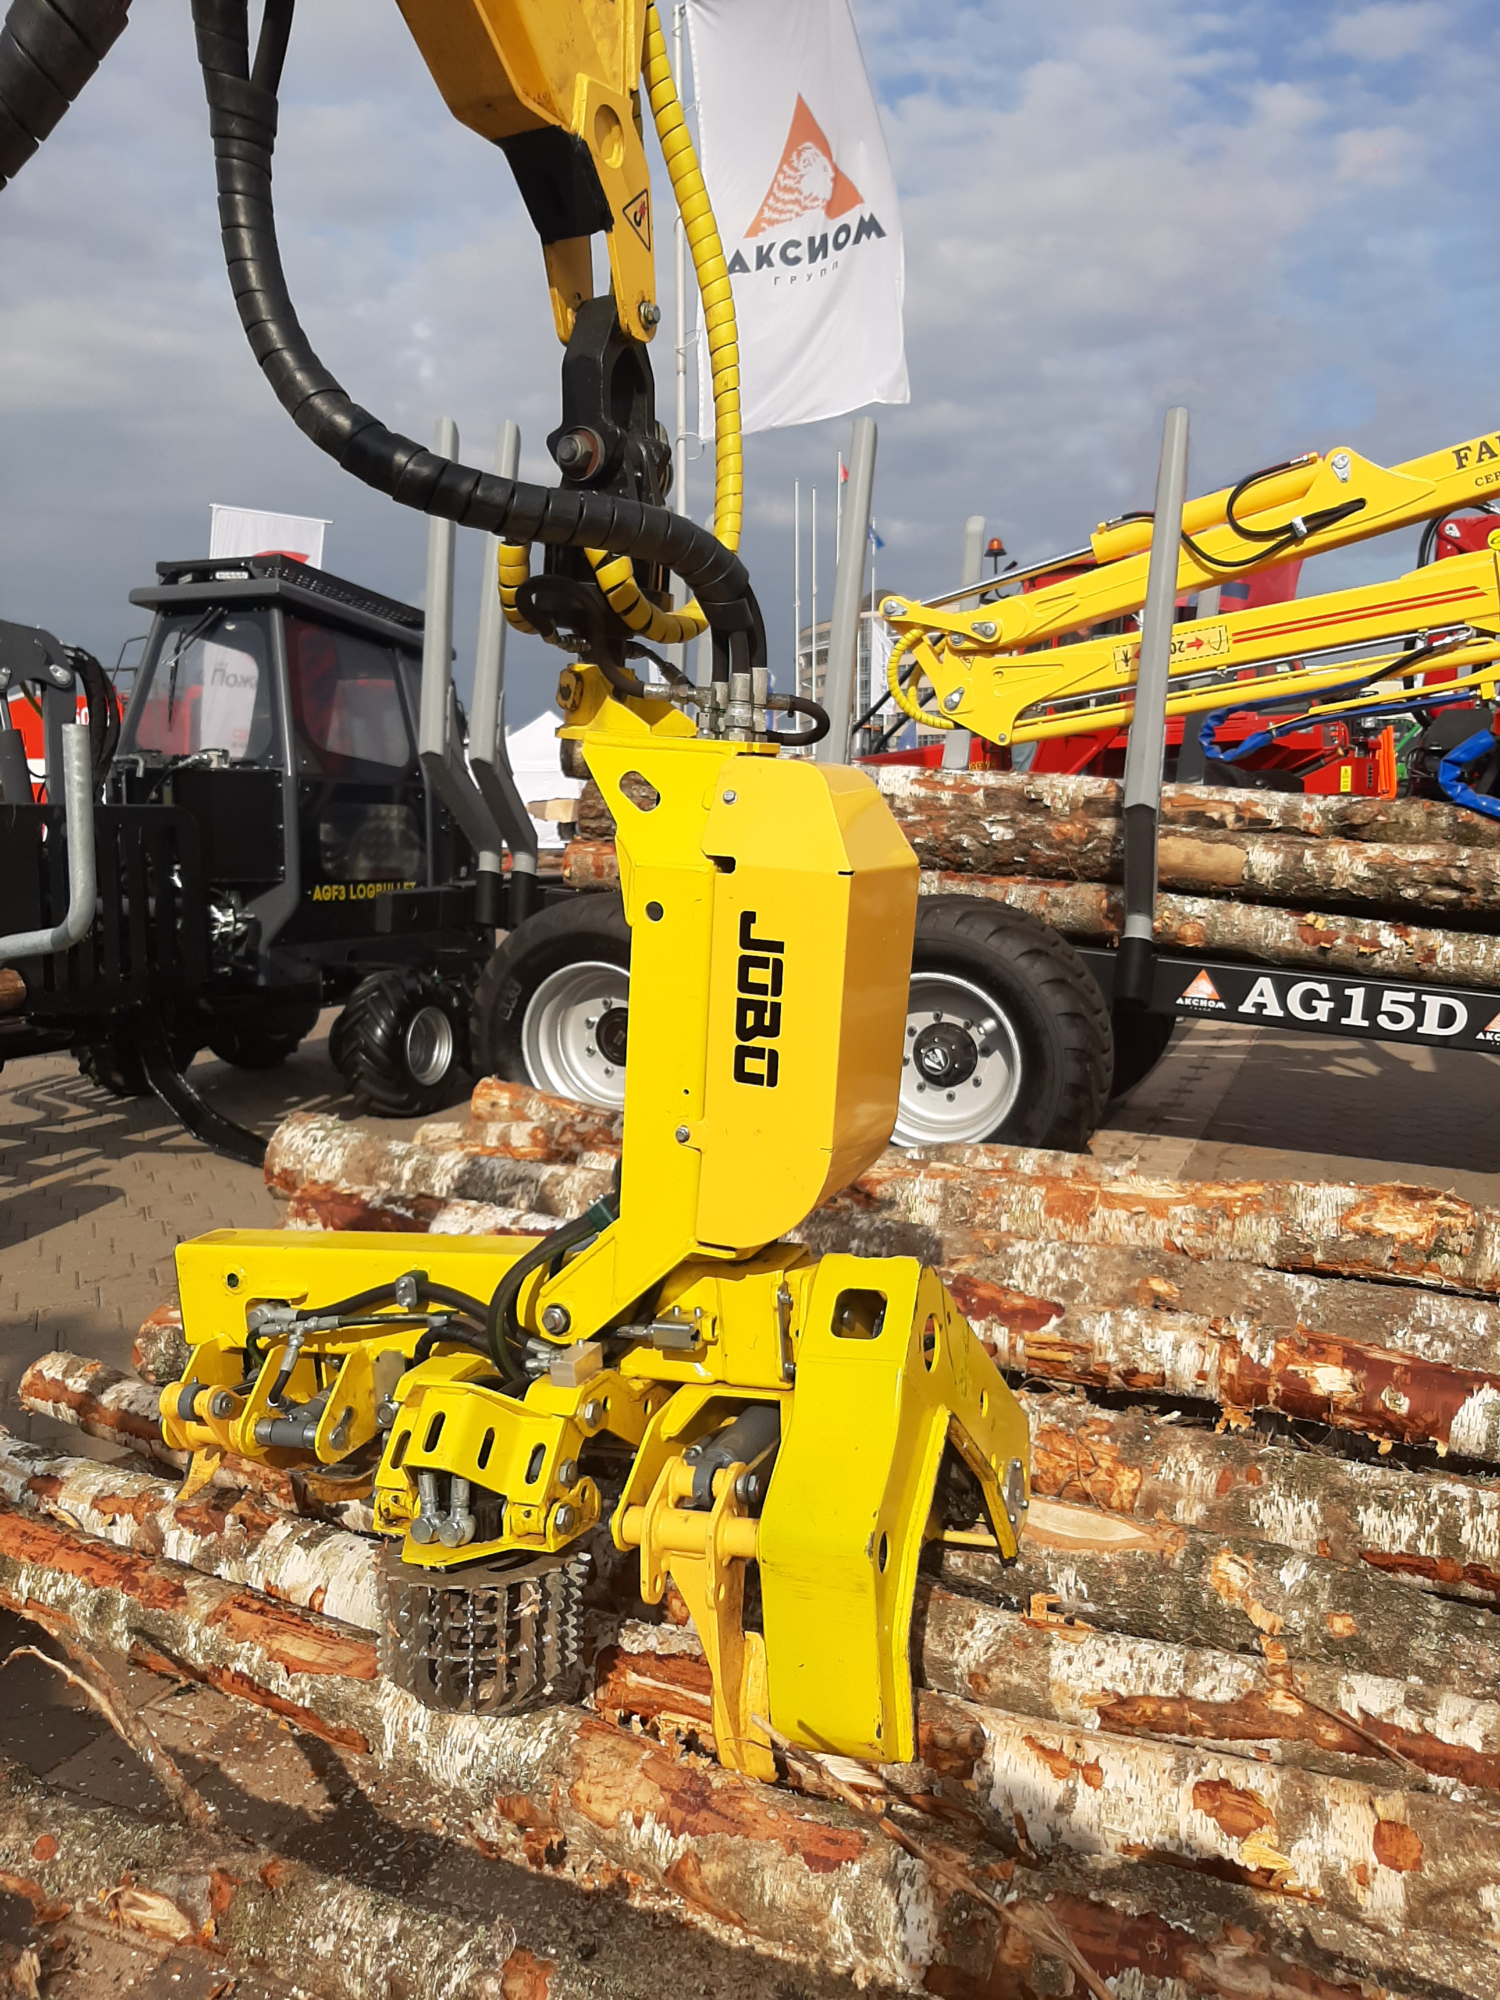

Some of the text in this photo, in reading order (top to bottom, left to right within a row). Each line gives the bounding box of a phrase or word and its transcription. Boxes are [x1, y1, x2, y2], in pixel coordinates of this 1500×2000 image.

[727, 212, 887, 275] АКСИОМ
[773, 260, 839, 286] ГРУПП
[312, 884, 346, 901] AGF3
[733, 910, 785, 1088] JOBO
[1237, 982, 1469, 1037] AG15D
